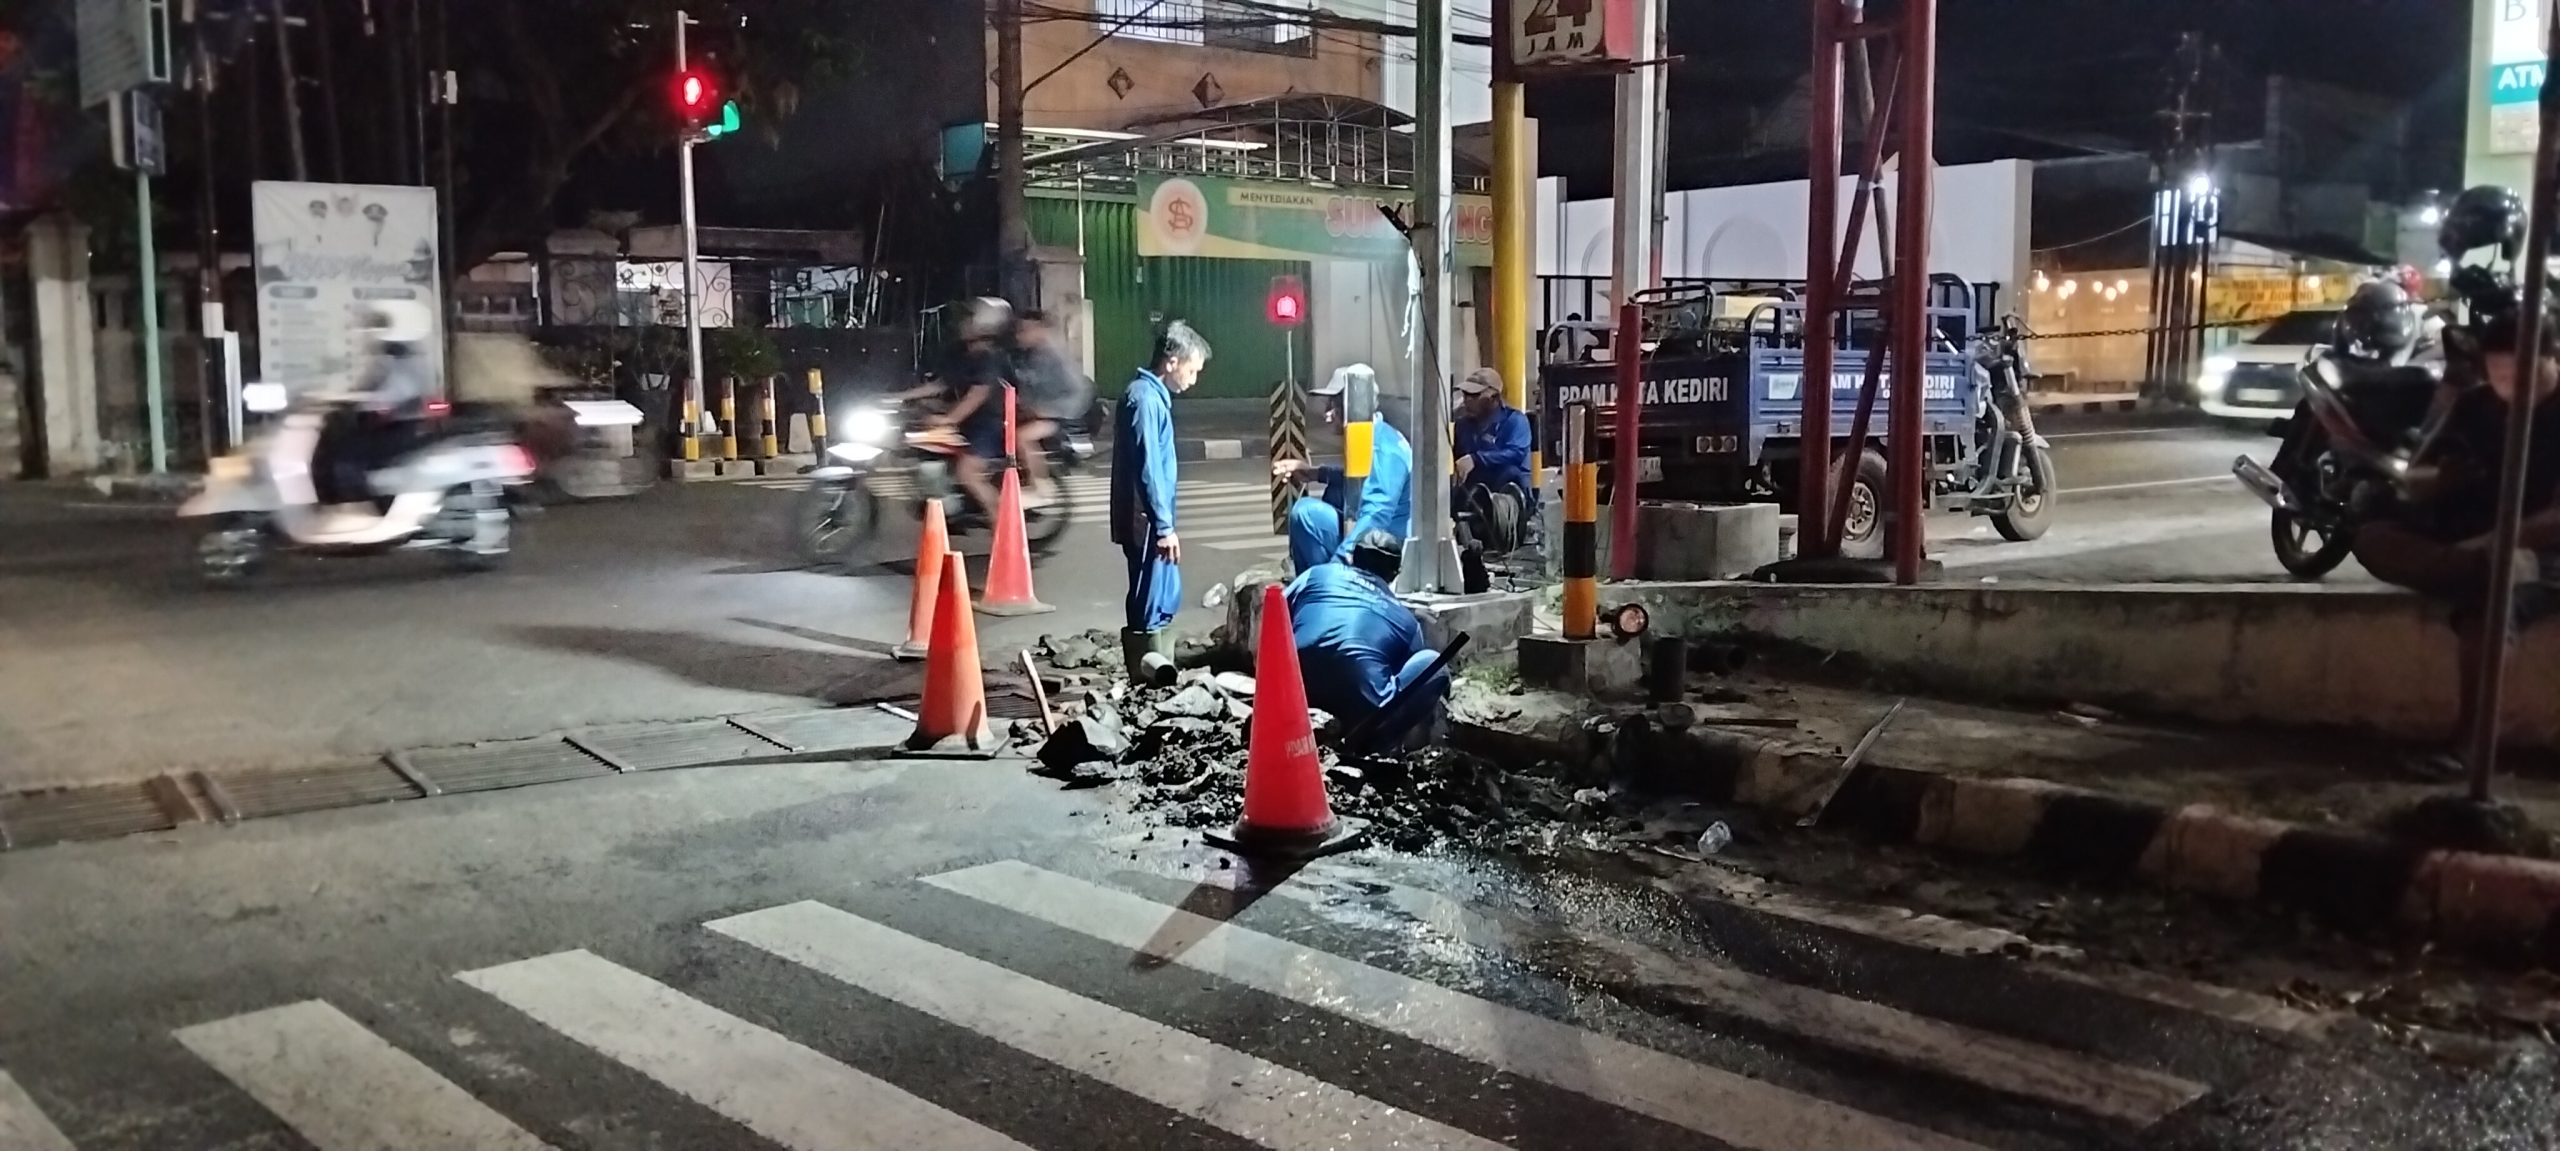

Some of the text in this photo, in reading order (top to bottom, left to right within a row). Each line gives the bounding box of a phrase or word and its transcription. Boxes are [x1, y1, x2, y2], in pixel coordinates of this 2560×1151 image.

[1527, 31, 1584, 56] JAM
[1240, 191, 1314, 205] MENYEDIAKAN
[1664, 377, 1729, 404] KEDIRI
